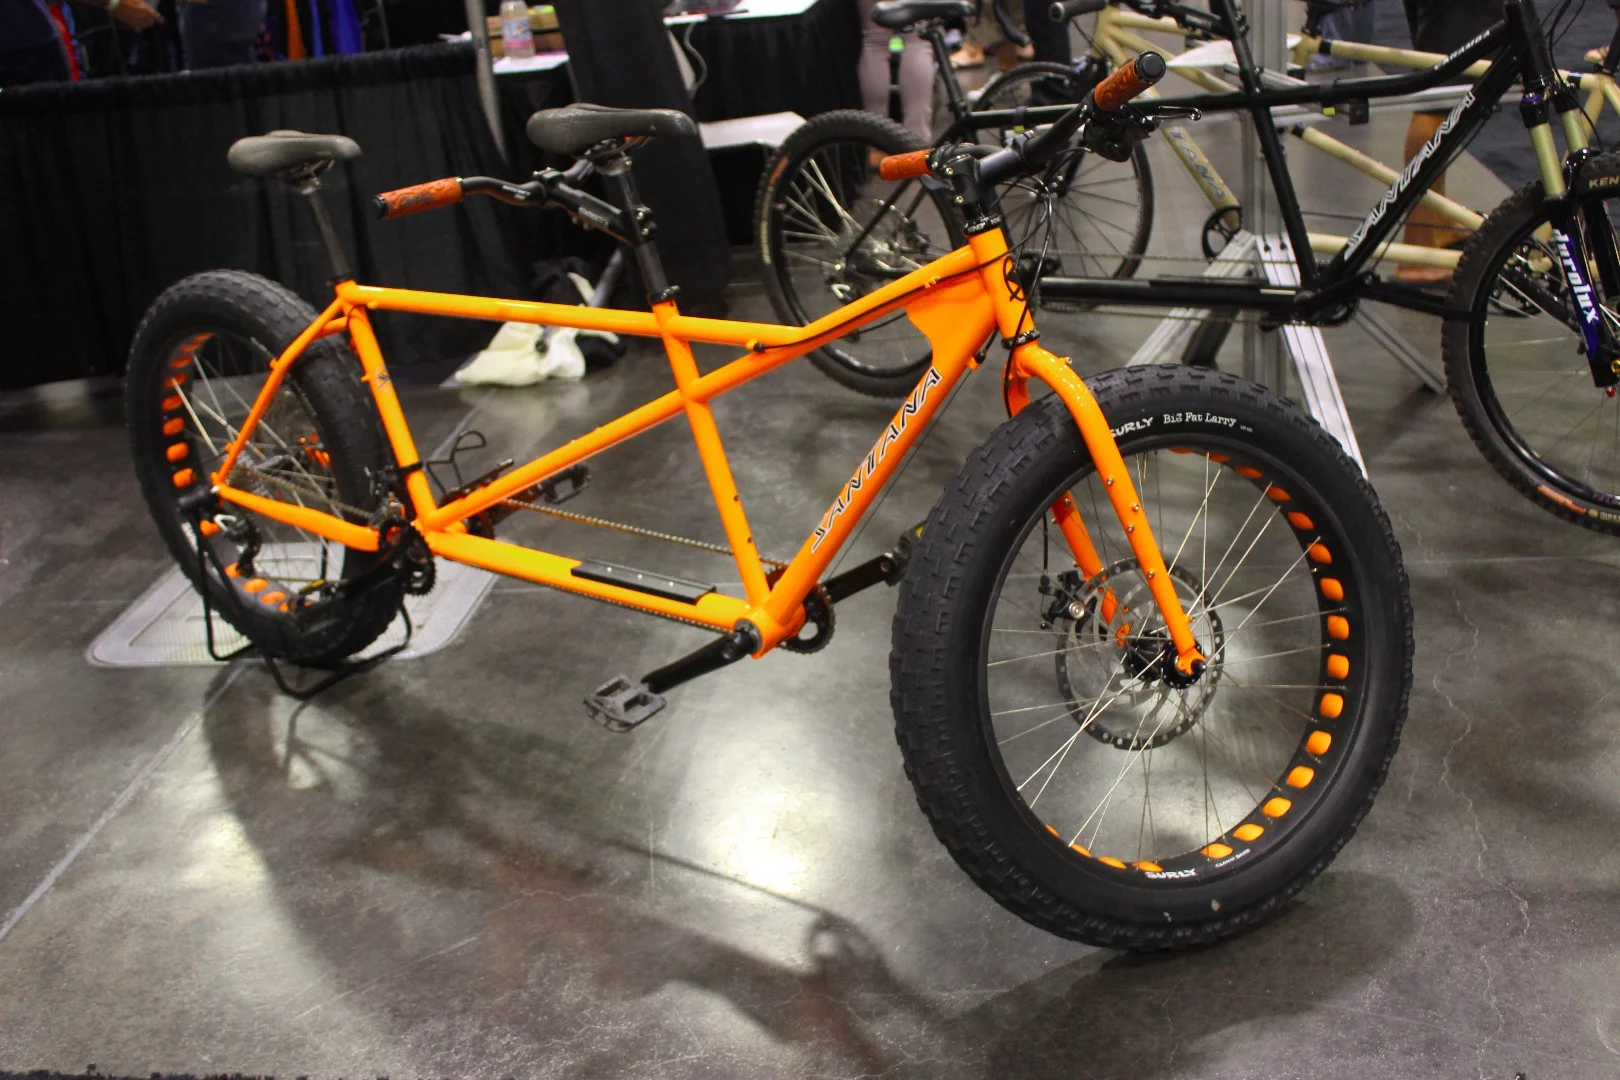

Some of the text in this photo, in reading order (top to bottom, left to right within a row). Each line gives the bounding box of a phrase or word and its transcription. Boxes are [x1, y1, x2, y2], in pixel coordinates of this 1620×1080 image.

[1343, 91, 1476, 262] SANTANA
[1552, 228, 1600, 325] durolux
[811, 366, 943, 554] SANTANA
[1184, 411, 1203, 423] Fat
[1204, 412, 1237, 428] Larry
[1145, 868, 1196, 879] SURLY
